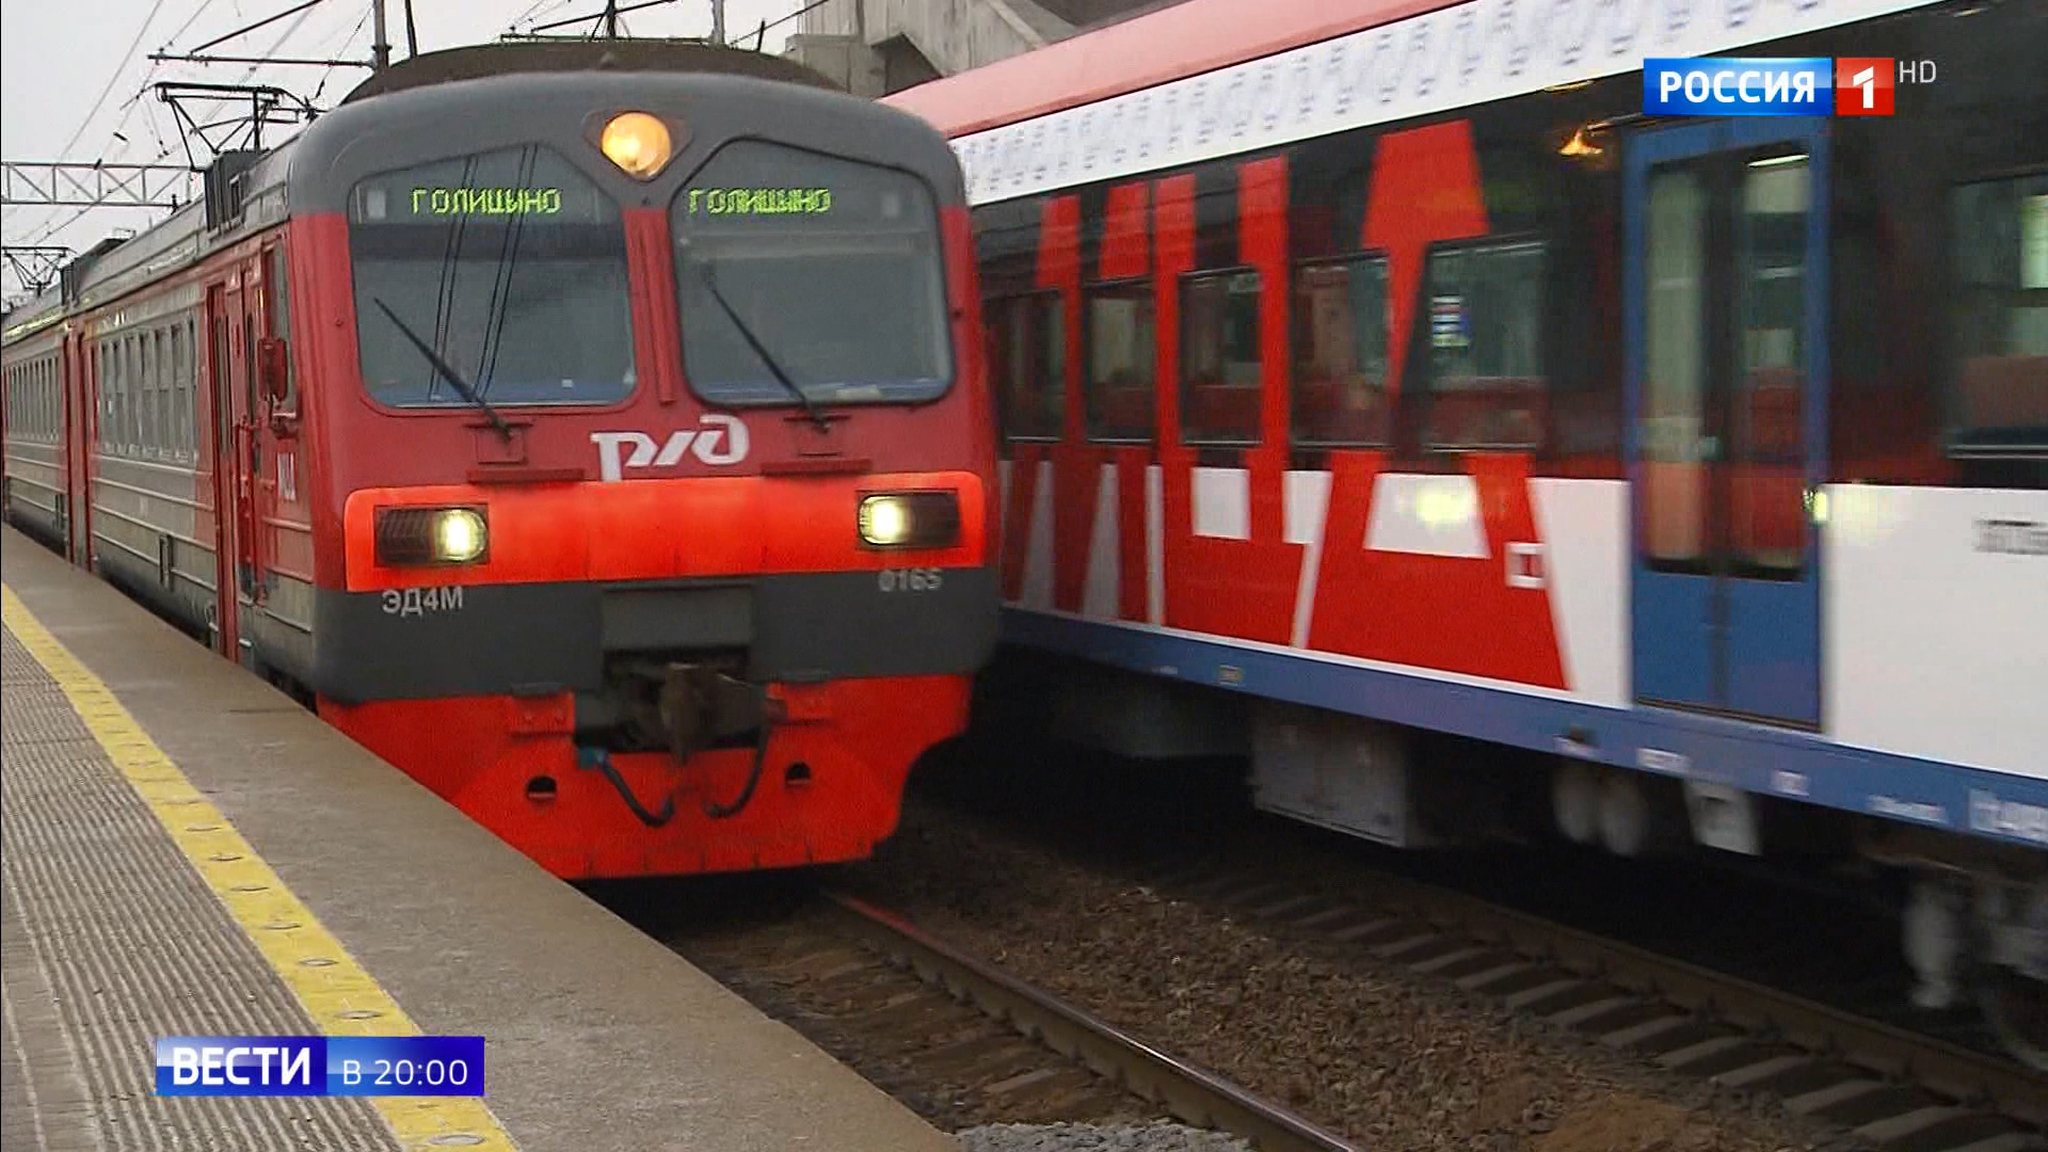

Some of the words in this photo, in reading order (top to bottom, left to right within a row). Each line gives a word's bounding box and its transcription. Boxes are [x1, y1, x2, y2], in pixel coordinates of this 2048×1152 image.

[411, 187, 563, 215] ГОЛИЦЫНО
[878, 568, 943, 592] 0165
[381, 585, 463, 618] ЭД4М
